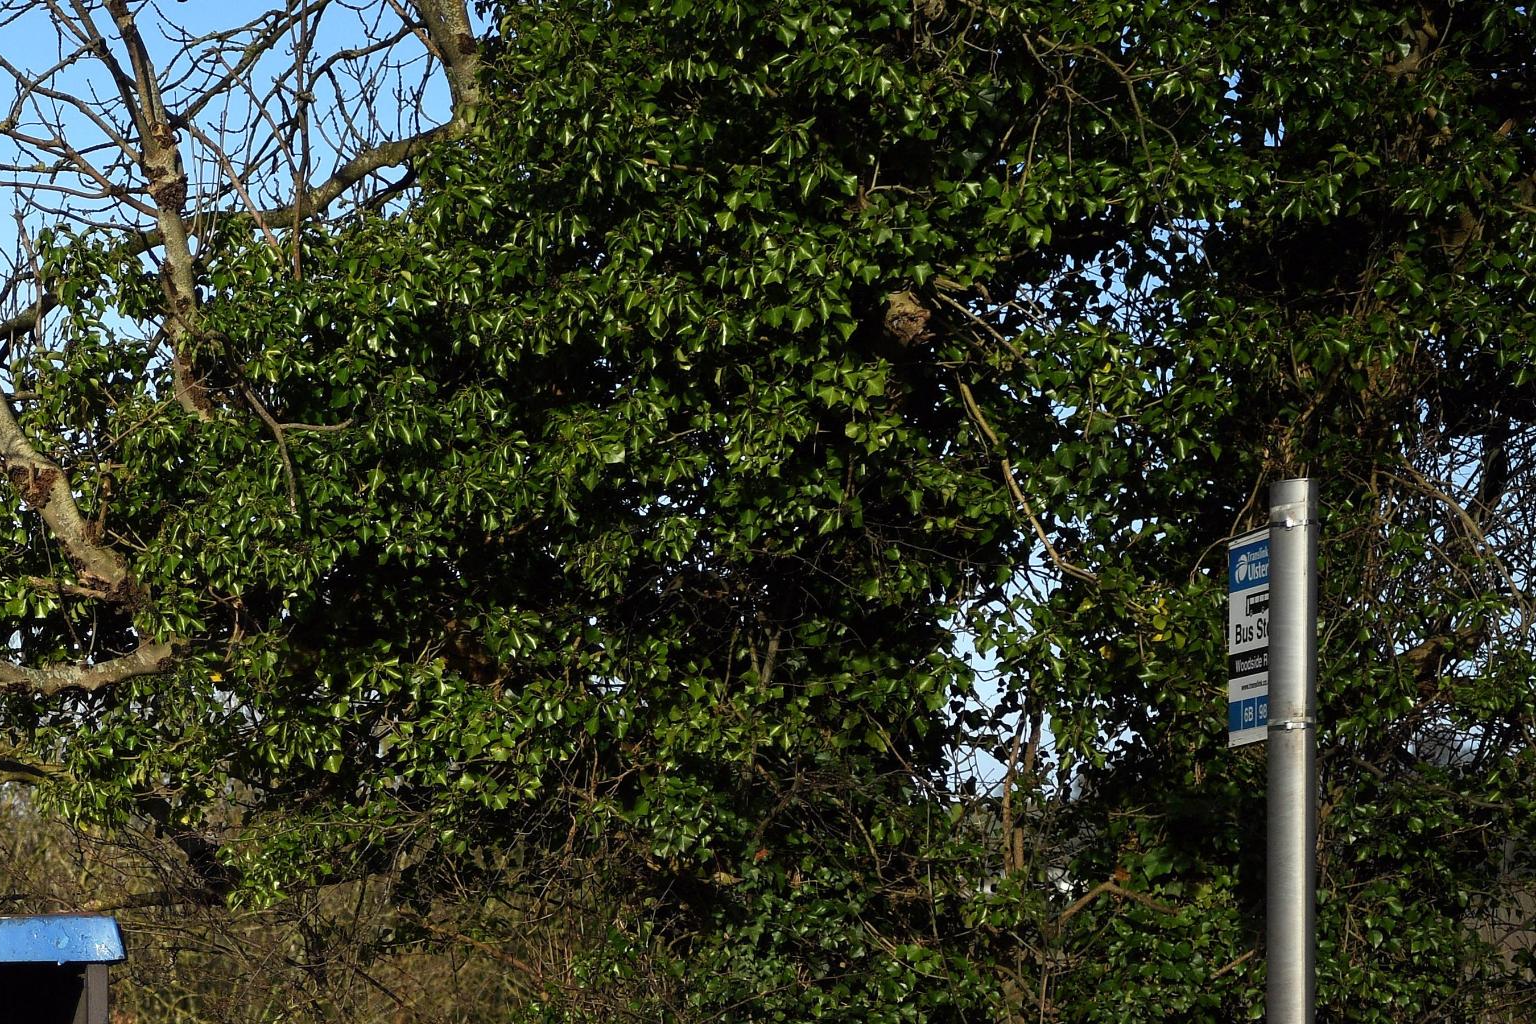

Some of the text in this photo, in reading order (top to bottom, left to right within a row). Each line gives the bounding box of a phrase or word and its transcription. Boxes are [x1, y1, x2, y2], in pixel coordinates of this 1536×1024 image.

[1248, 561, 1269, 581] Ulster
[1235, 623, 1254, 645] Bus
[1235, 655, 1263, 673] Woodside
[1244, 706, 1254, 722] 6B
